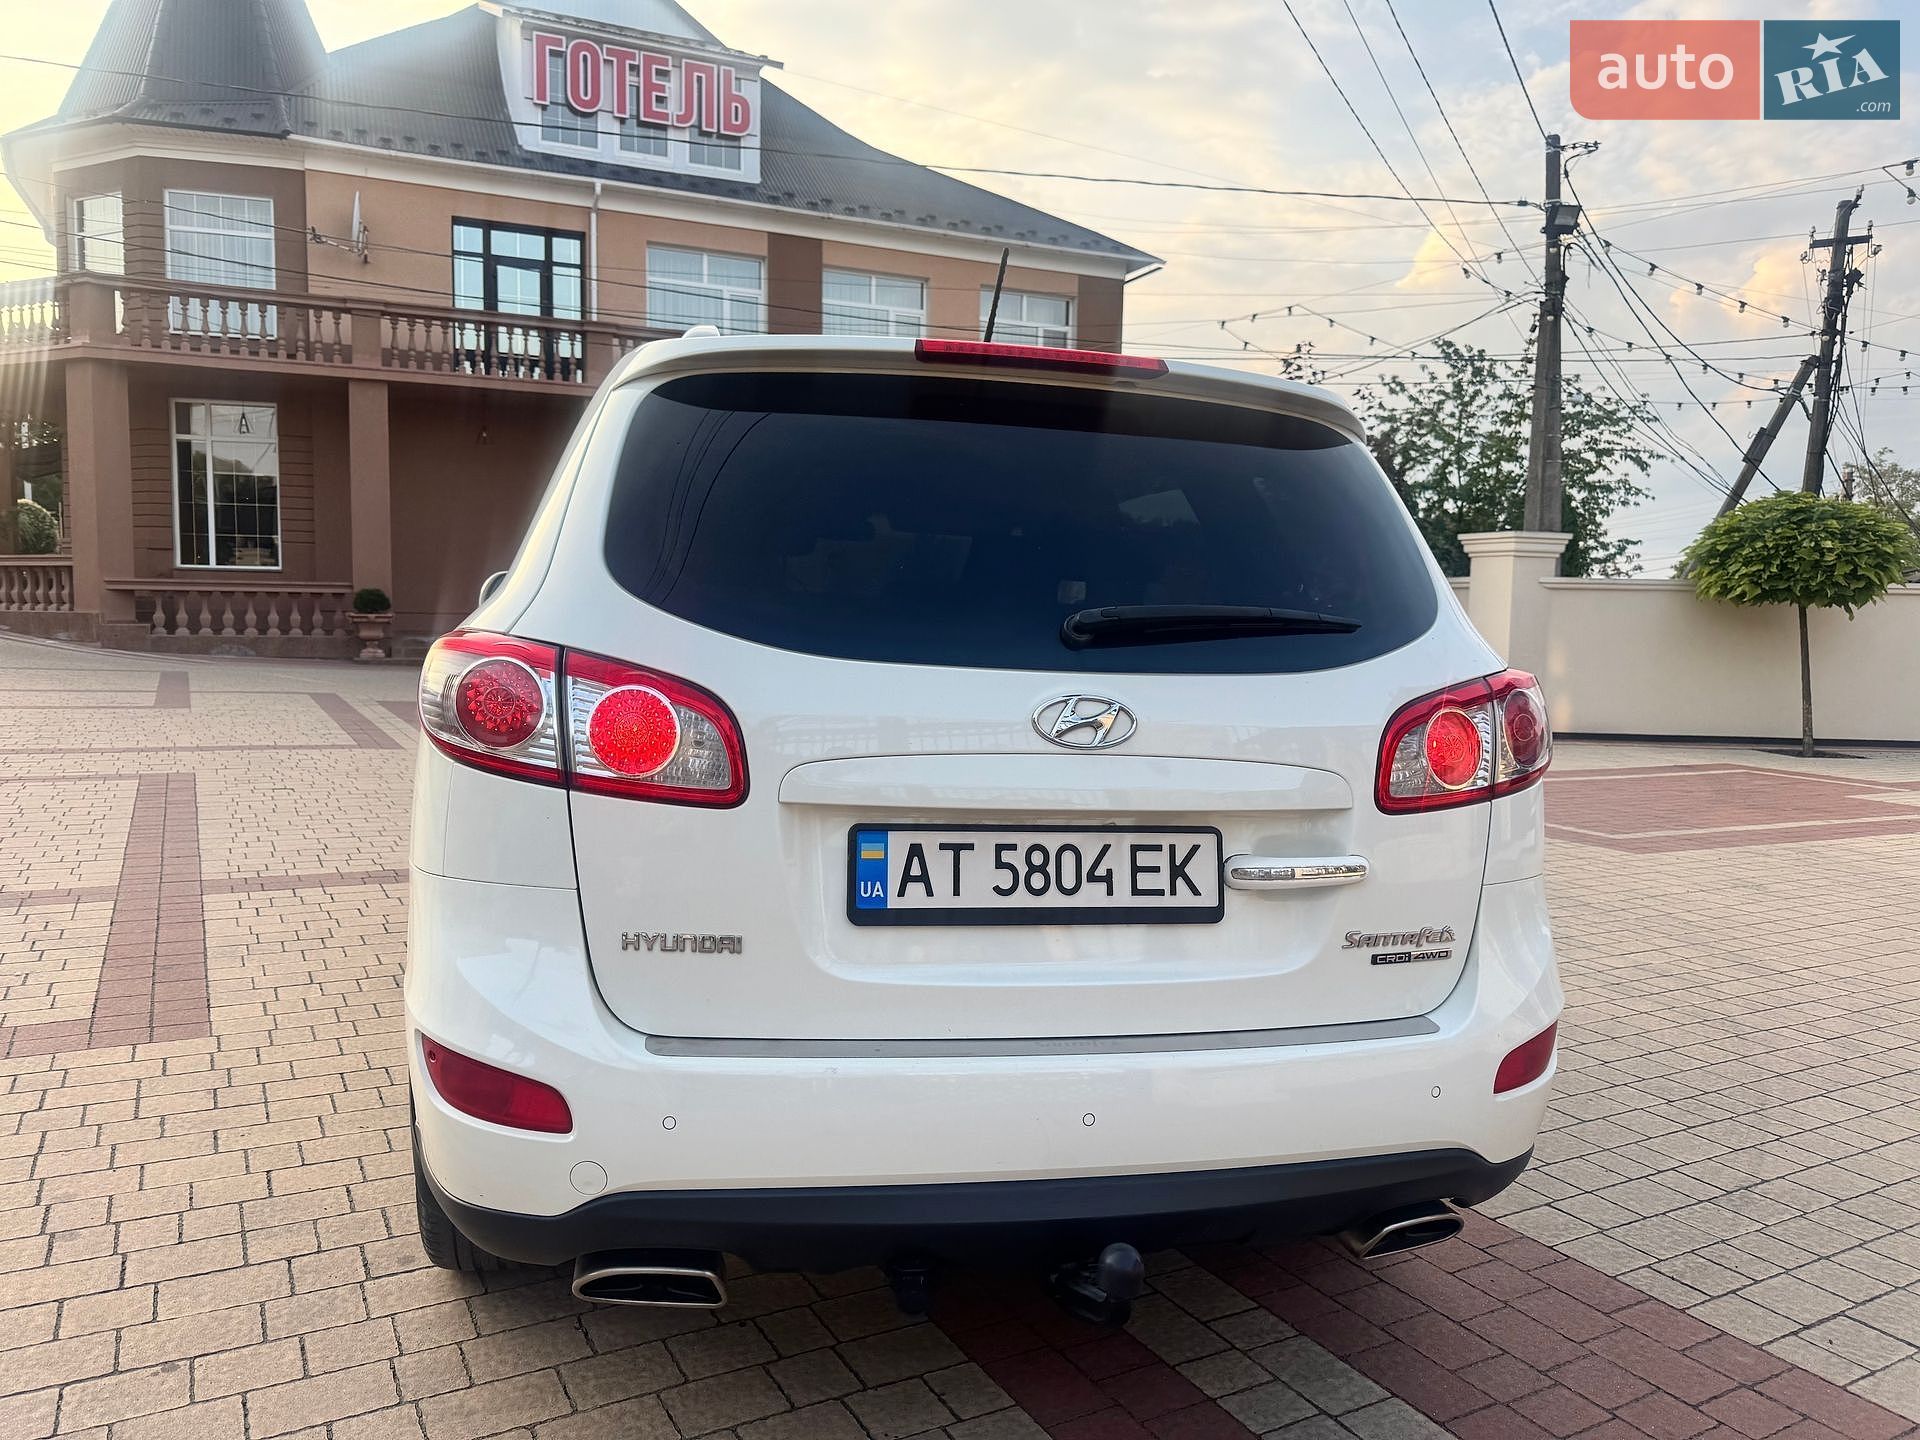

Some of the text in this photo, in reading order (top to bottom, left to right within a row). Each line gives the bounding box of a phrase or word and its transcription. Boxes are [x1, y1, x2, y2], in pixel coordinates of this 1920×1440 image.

[532, 30, 750, 137] ГОТЕЛЬ
[860, 881, 884, 898] UA
[897, 843, 1202, 898] AT 5804 EK
[621, 931, 743, 954] HYUNDAI
